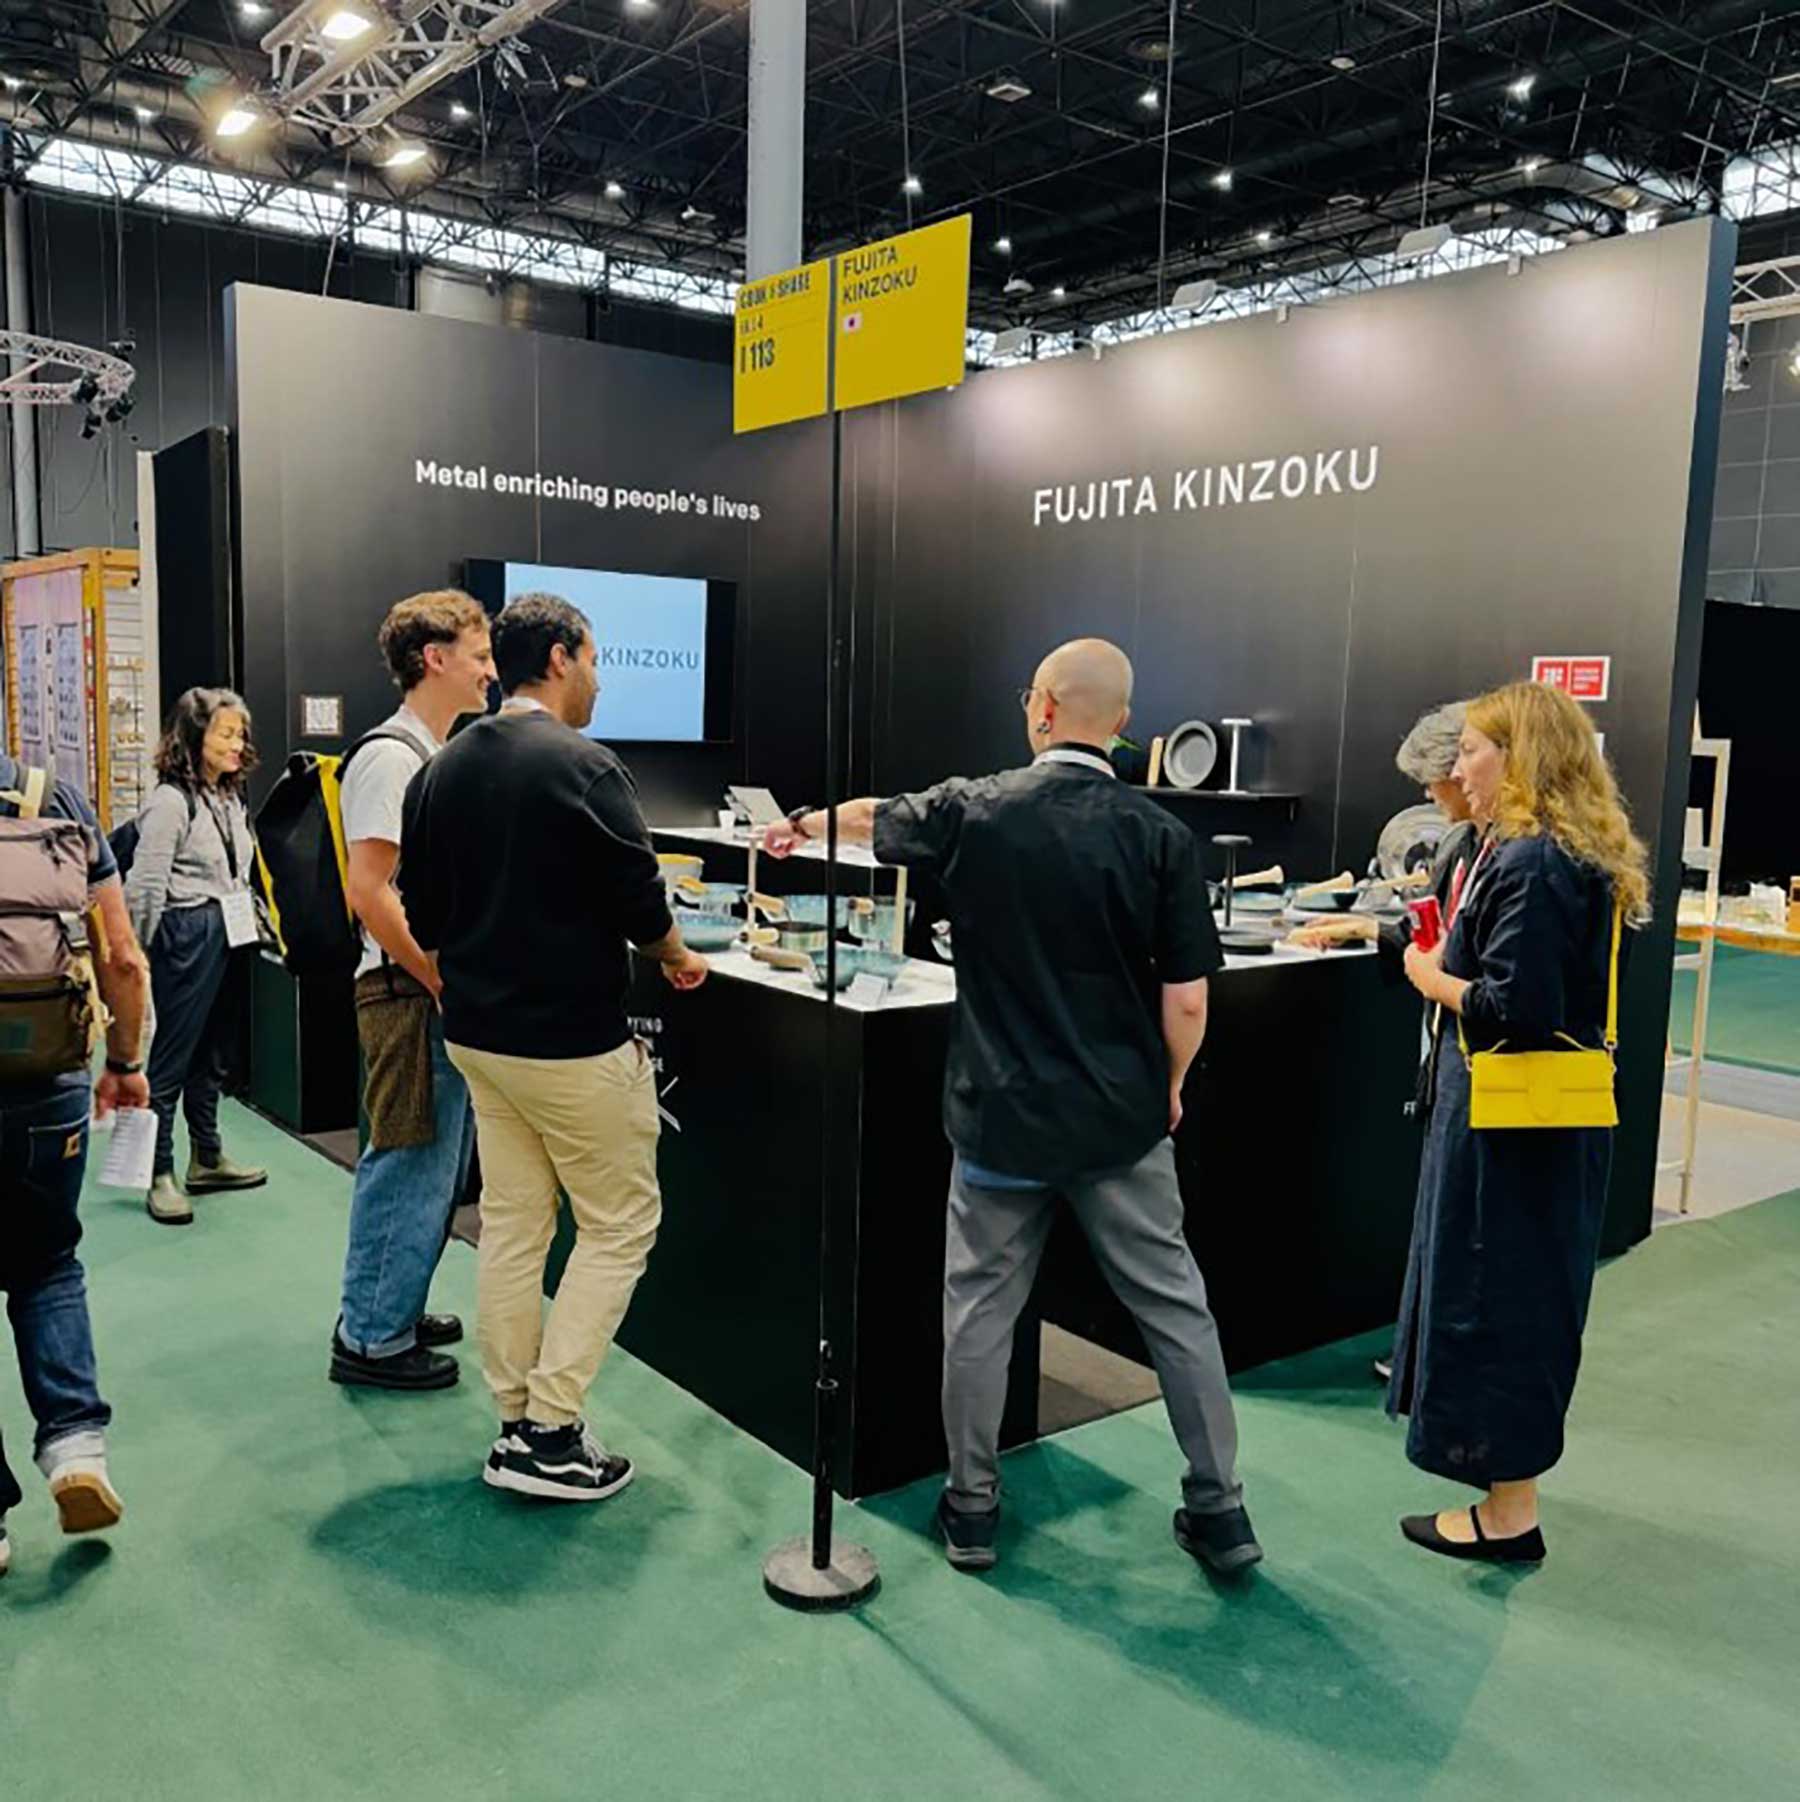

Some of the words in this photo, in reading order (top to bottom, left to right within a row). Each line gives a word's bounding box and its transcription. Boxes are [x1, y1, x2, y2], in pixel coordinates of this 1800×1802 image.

[843, 245, 898, 279] FUJITA
[843, 264, 917, 306] KINZOKU
[750, 338, 775, 371] 113
[415, 459, 487, 490] Metal
[493, 472, 608, 508] enriching
[613, 486, 709, 515] people's
[712, 495, 762, 521] lives
[1033, 475, 1158, 527] FUJITA
[1173, 445, 1379, 512] KINZOKU
[601, 645, 699, 670] KINZOKU
